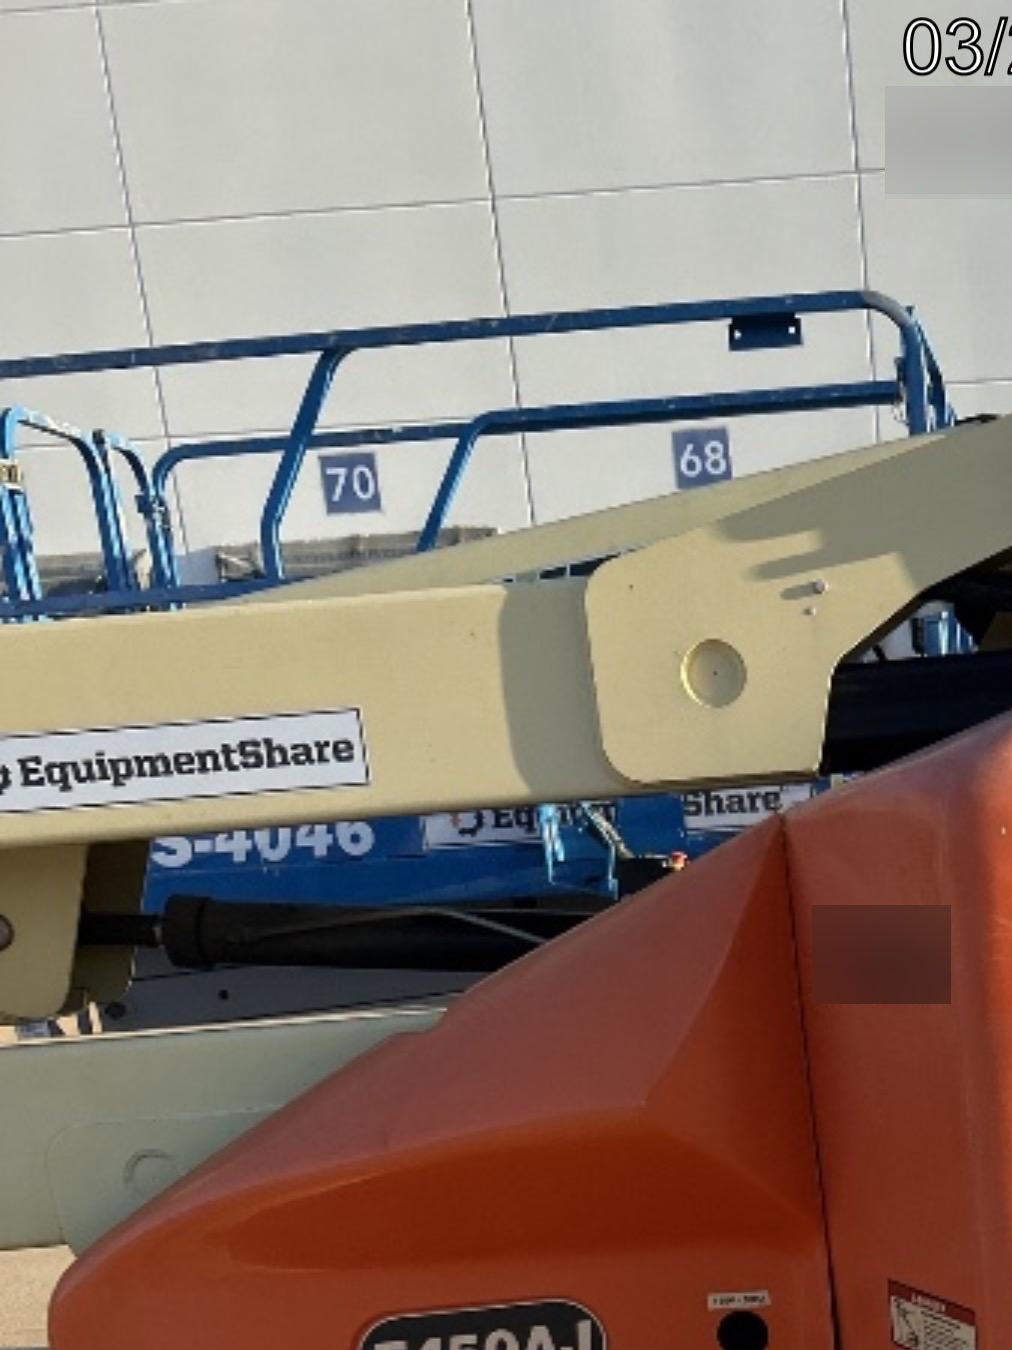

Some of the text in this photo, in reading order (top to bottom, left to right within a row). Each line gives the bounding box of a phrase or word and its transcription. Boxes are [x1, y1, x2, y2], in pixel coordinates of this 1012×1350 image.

[680, 440, 727, 478] 68
[325, 464, 376, 502] 70
[18, 738, 355, 793] EquipmentShare
